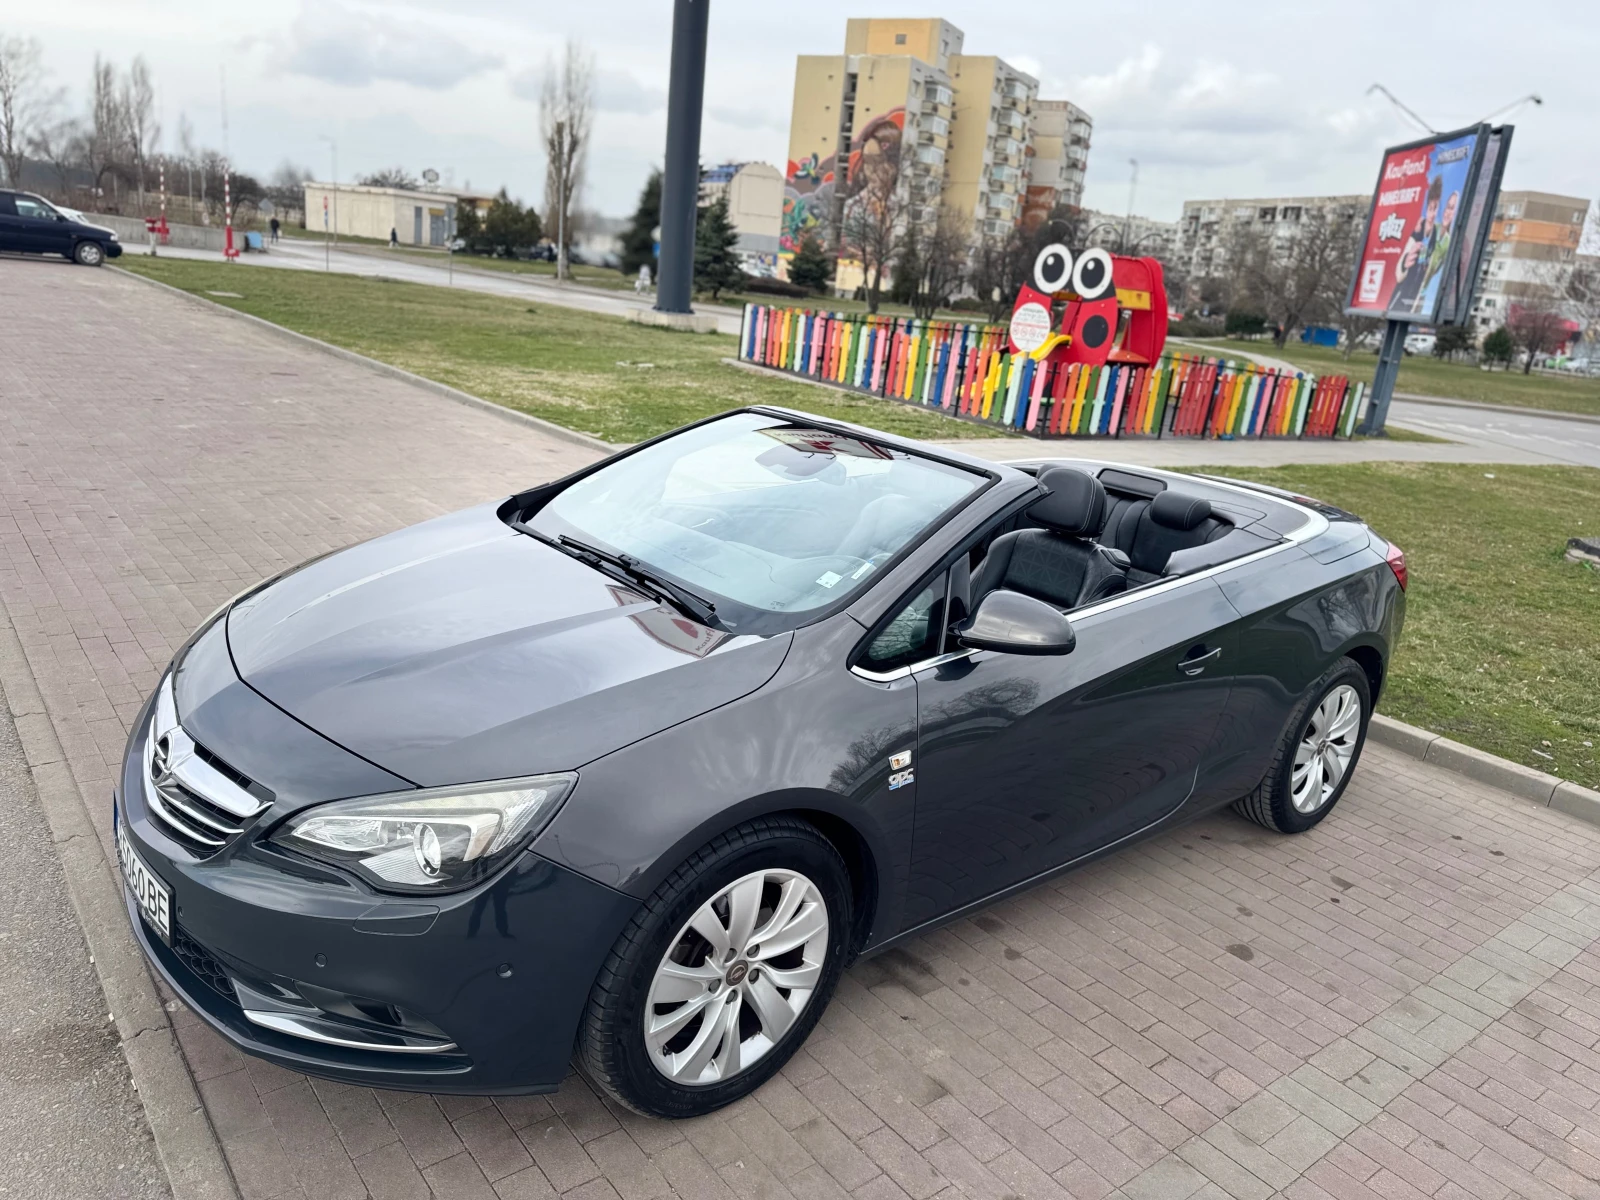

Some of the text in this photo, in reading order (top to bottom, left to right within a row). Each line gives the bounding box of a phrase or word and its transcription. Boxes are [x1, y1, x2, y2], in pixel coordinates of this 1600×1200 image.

[1384, 154, 1426, 180] Kaufland
[1378, 187, 1421, 206] MINECRAFT
[147, 877, 168, 932] BE
